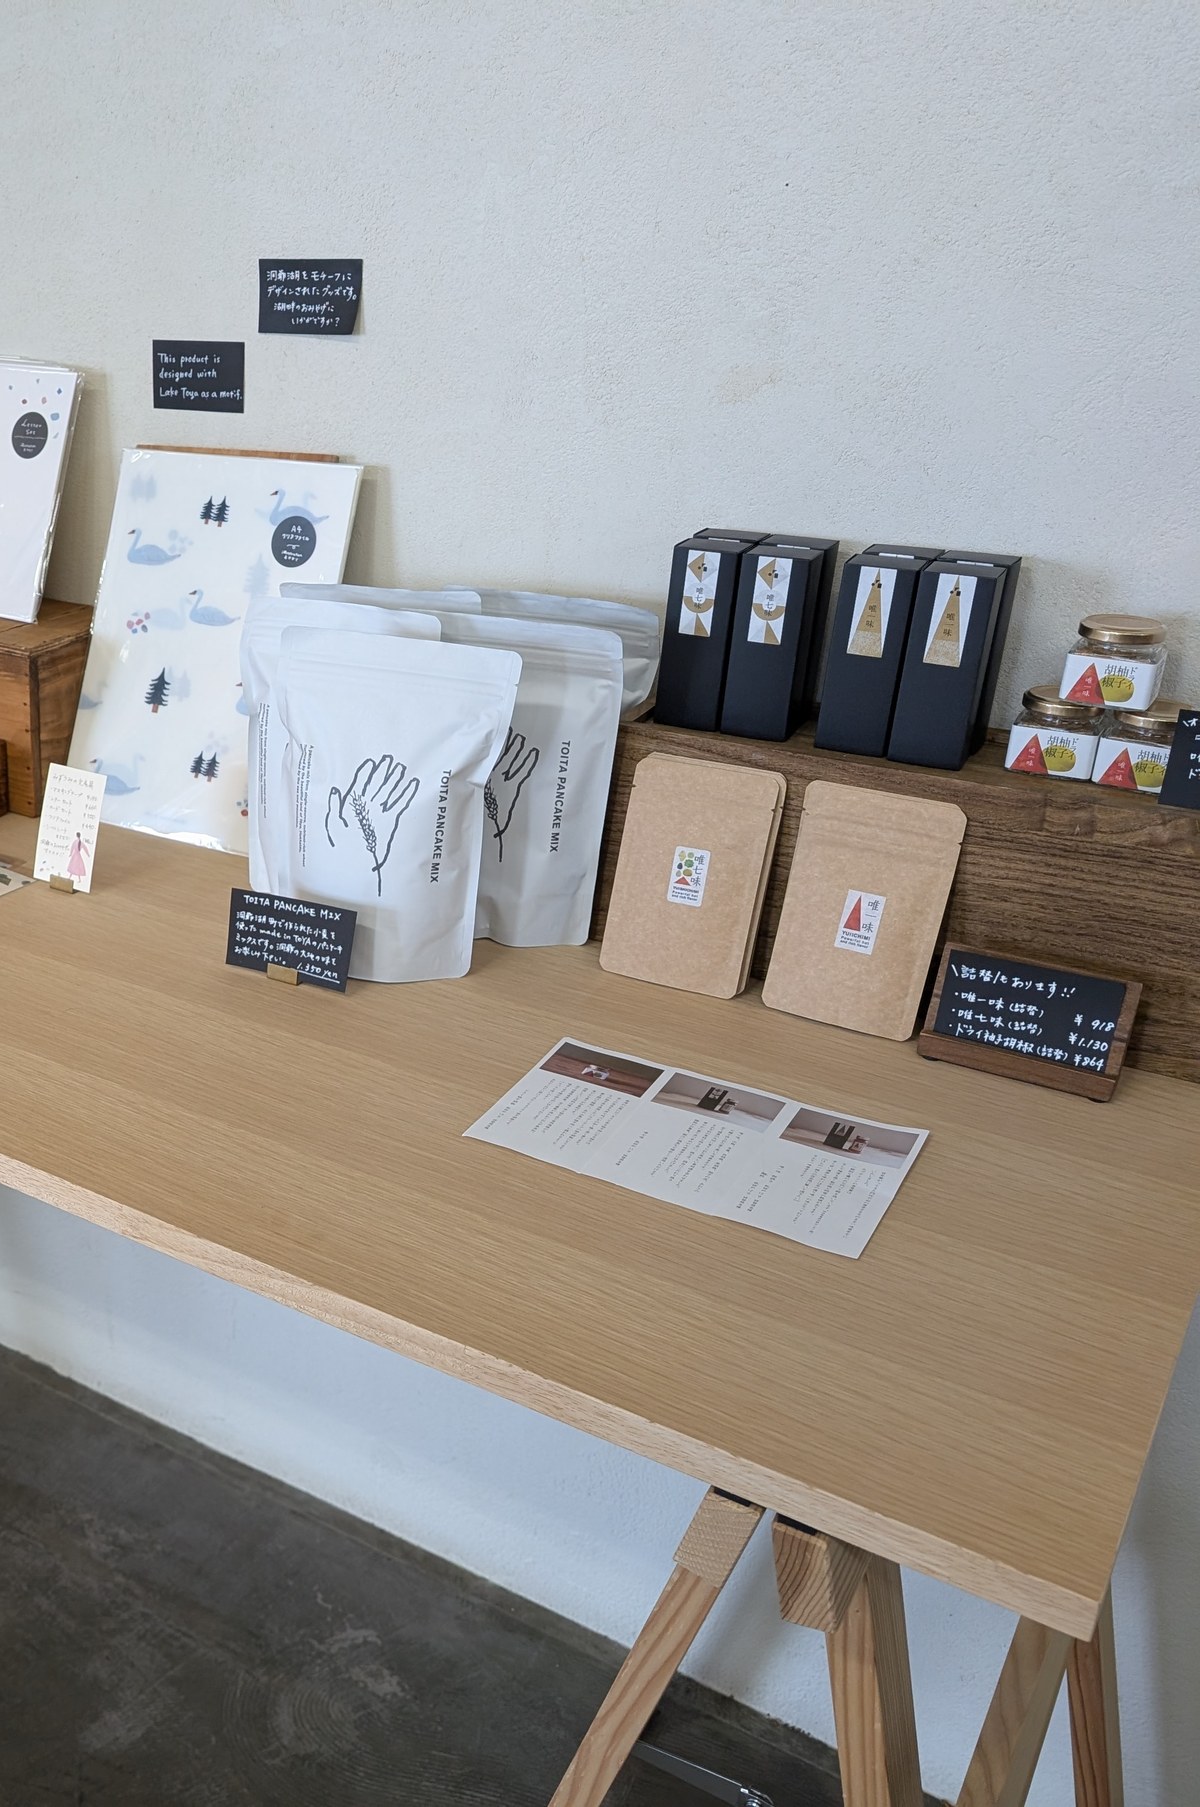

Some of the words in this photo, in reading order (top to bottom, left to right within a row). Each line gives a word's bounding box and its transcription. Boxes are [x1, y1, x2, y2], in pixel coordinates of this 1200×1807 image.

[266, 270, 352, 282] 洞爺湖をモチーフに
[266, 285, 357, 301] デザインされたグッズです。
[274, 301, 334, 314] 湖畔のおみやげに
[157, 353, 176, 364] This
[180, 354, 208, 368] product
[214, 354, 220, 364] is
[159, 368, 193, 382] designed
[197, 369, 217, 379] with
[160, 387, 178, 397] Lake
[181, 388, 199, 400] Toya
[201, 390, 210, 398] as
[220, 388, 242, 400] motif.
[291, 525, 302, 534] A4
[866, 604, 877, 628] 唯一味
[942, 613, 955, 637] 唯一味
[1082, 676, 1092, 697] 唯一味
[559, 740, 571, 773] TOITA
[438, 769, 452, 803] TOITA
[552, 776, 567, 829] PANCAKE
[432, 806, 447, 860] PANCAKE
[550, 832, 560, 853] MIX
[430, 862, 440, 883] MIX
[690, 854, 705, 886] 唯七味
[244, 895, 270, 906] TOITA
[274, 900, 316, 917] PANCAKE
[320, 909, 341, 920] MIX
[862, 900, 880, 933] 唯一味
[260, 928, 281, 938] made
[842, 930, 870, 941] YUIICHIMI
[322, 969, 338, 979] yen
[1074, 1054, 1105, 1071] ¥864
